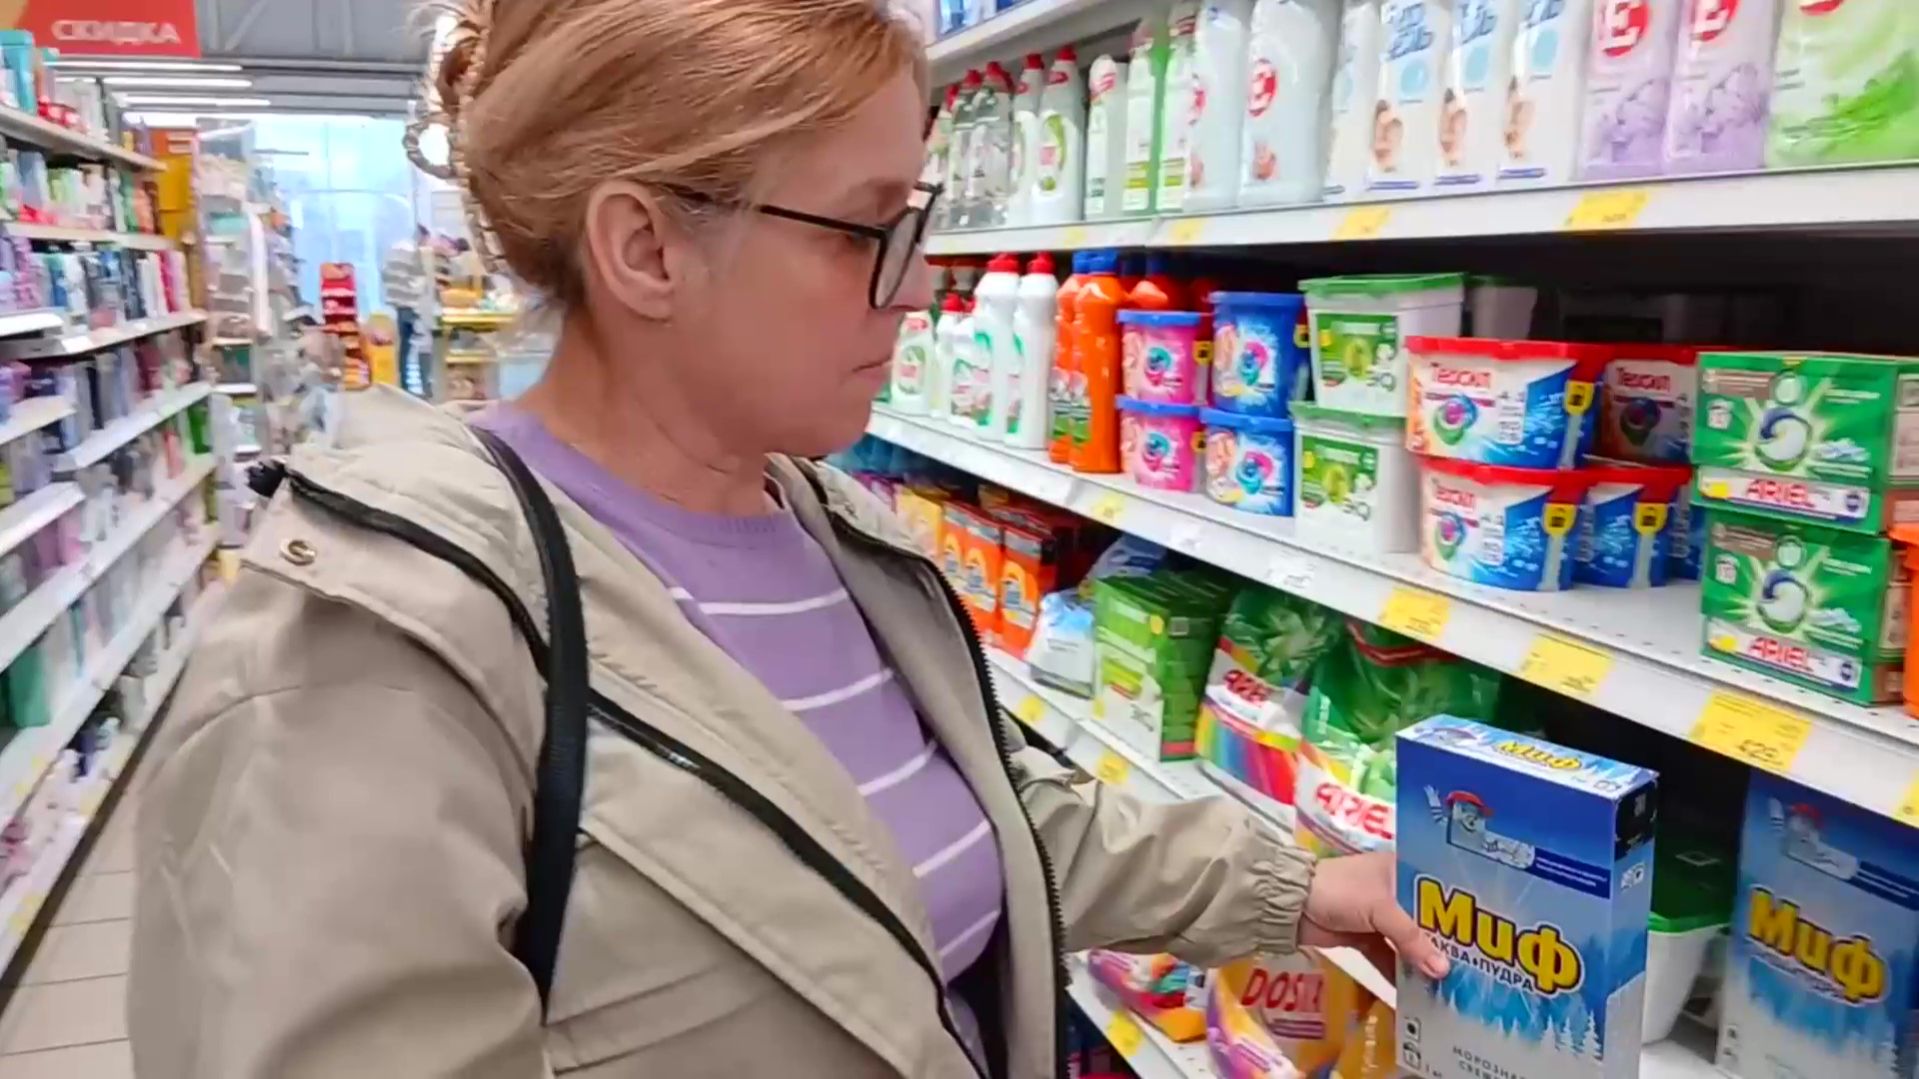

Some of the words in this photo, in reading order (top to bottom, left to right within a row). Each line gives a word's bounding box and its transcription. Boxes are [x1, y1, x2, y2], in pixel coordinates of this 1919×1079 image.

[51, 20, 181, 45] СКИДКА
[1747, 479, 1815, 508] ARIEL
[1750, 636, 1814, 672] ARIEL
[1497, 742, 1582, 769] Миф
[1416, 878, 1583, 994] Миф
[1748, 886, 1889, 1004] Миф
